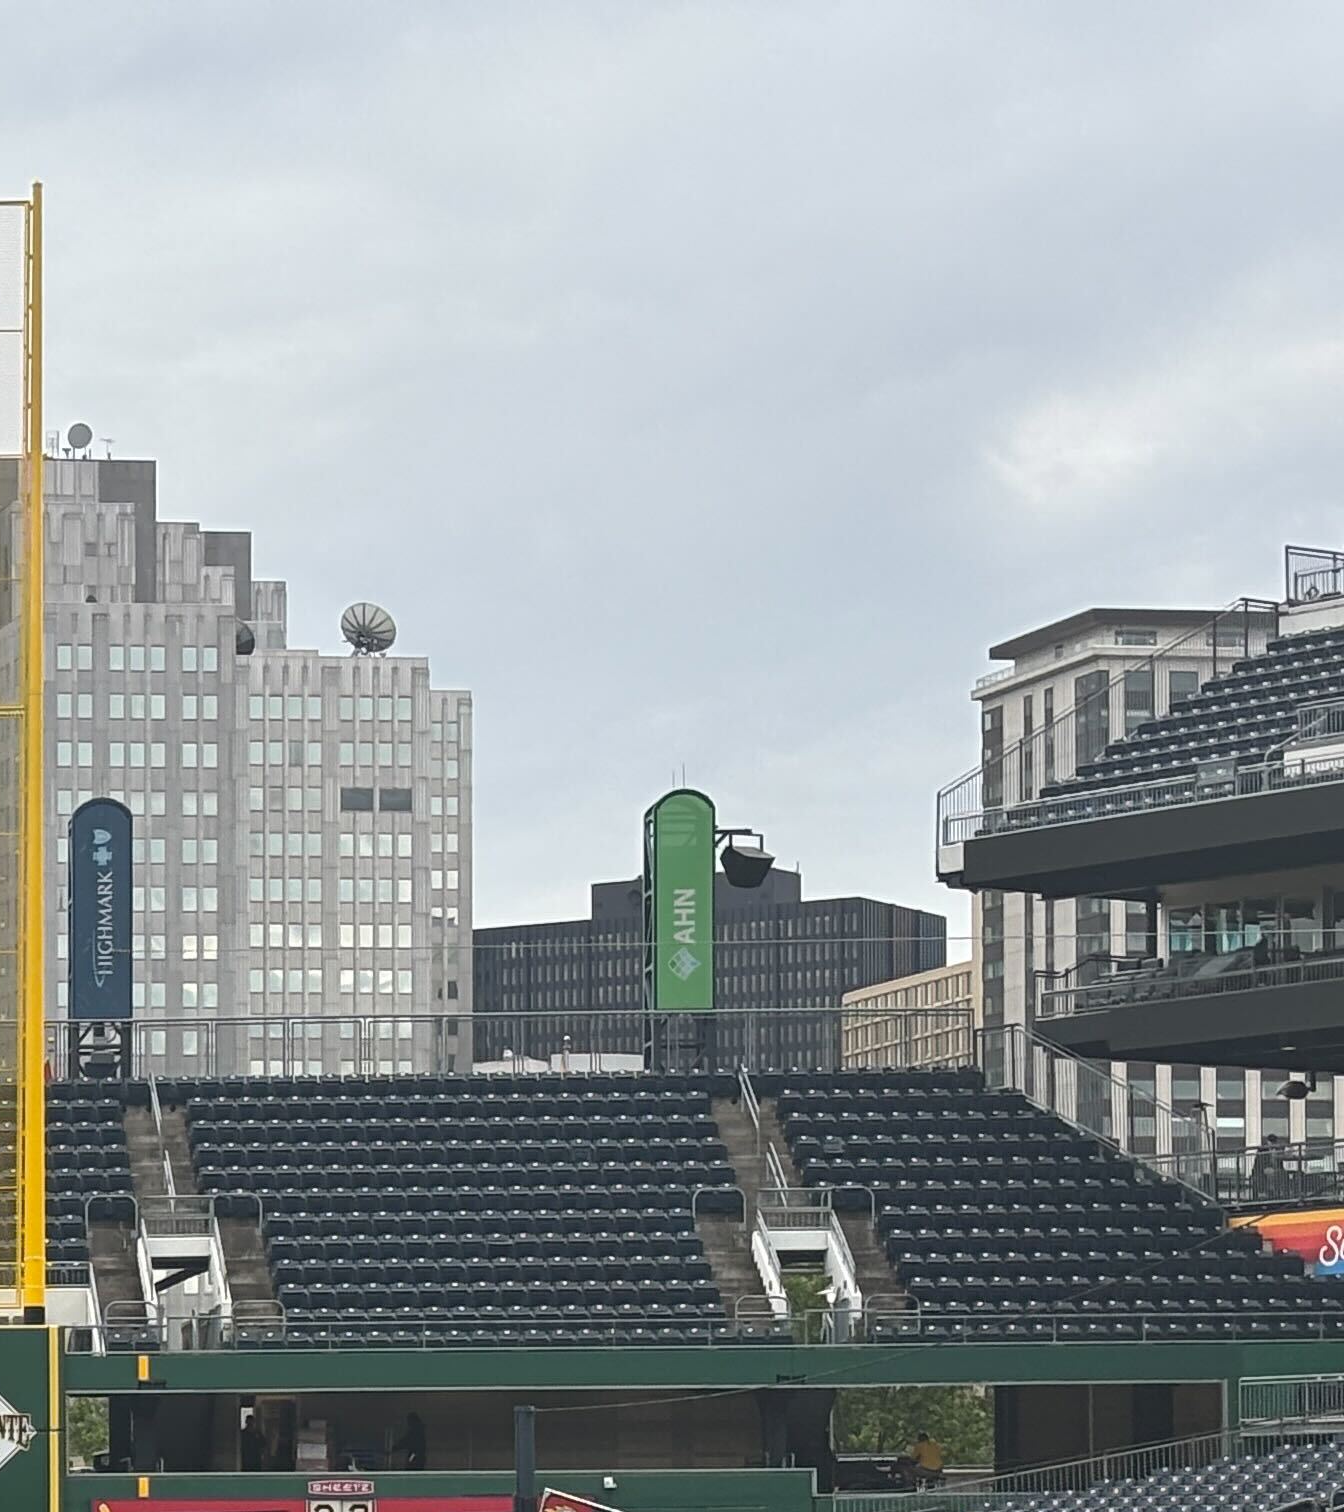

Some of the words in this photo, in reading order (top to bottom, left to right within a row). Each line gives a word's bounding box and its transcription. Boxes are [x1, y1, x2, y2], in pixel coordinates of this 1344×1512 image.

[94, 871, 113, 981] HIGHMARK
[673, 888, 695, 945] AHN
[1319, 1225, 1344, 1266] S
[312, 1483, 370, 1492] SHEETZ
